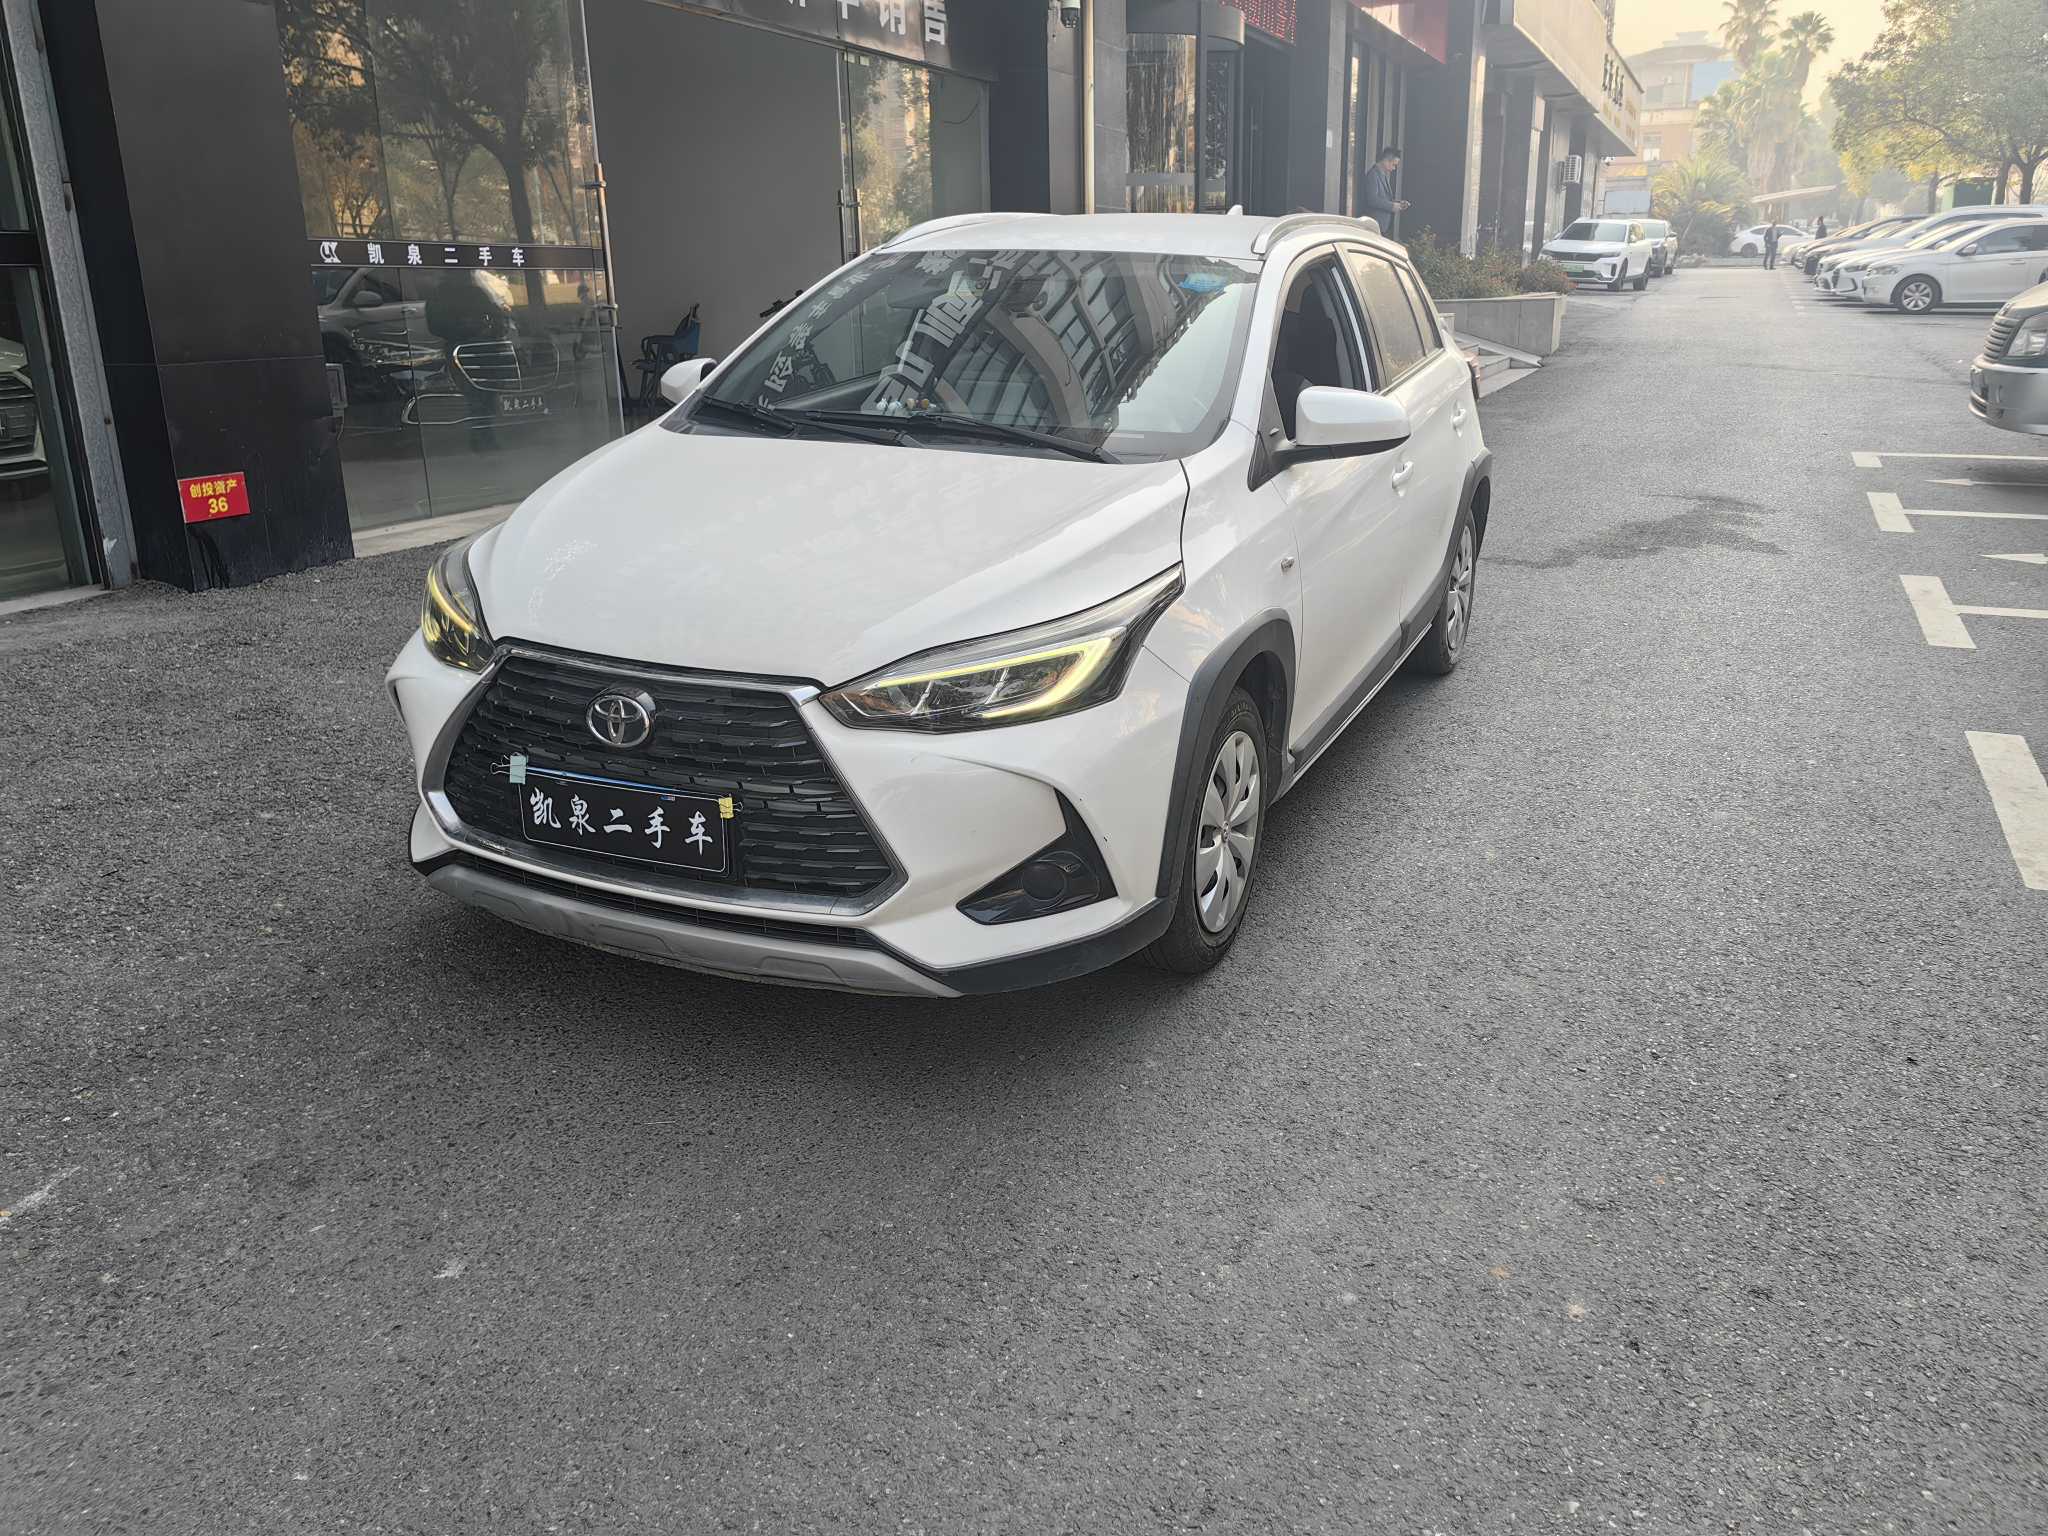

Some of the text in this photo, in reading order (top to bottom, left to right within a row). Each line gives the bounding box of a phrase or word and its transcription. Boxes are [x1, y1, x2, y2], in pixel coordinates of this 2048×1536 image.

[366, 242, 526, 267] 凯泉二手车
[189, 479, 237, 498] 创投资产
[208, 497, 228, 514] 36
[529, 786, 713, 856] 凯泉二手车
